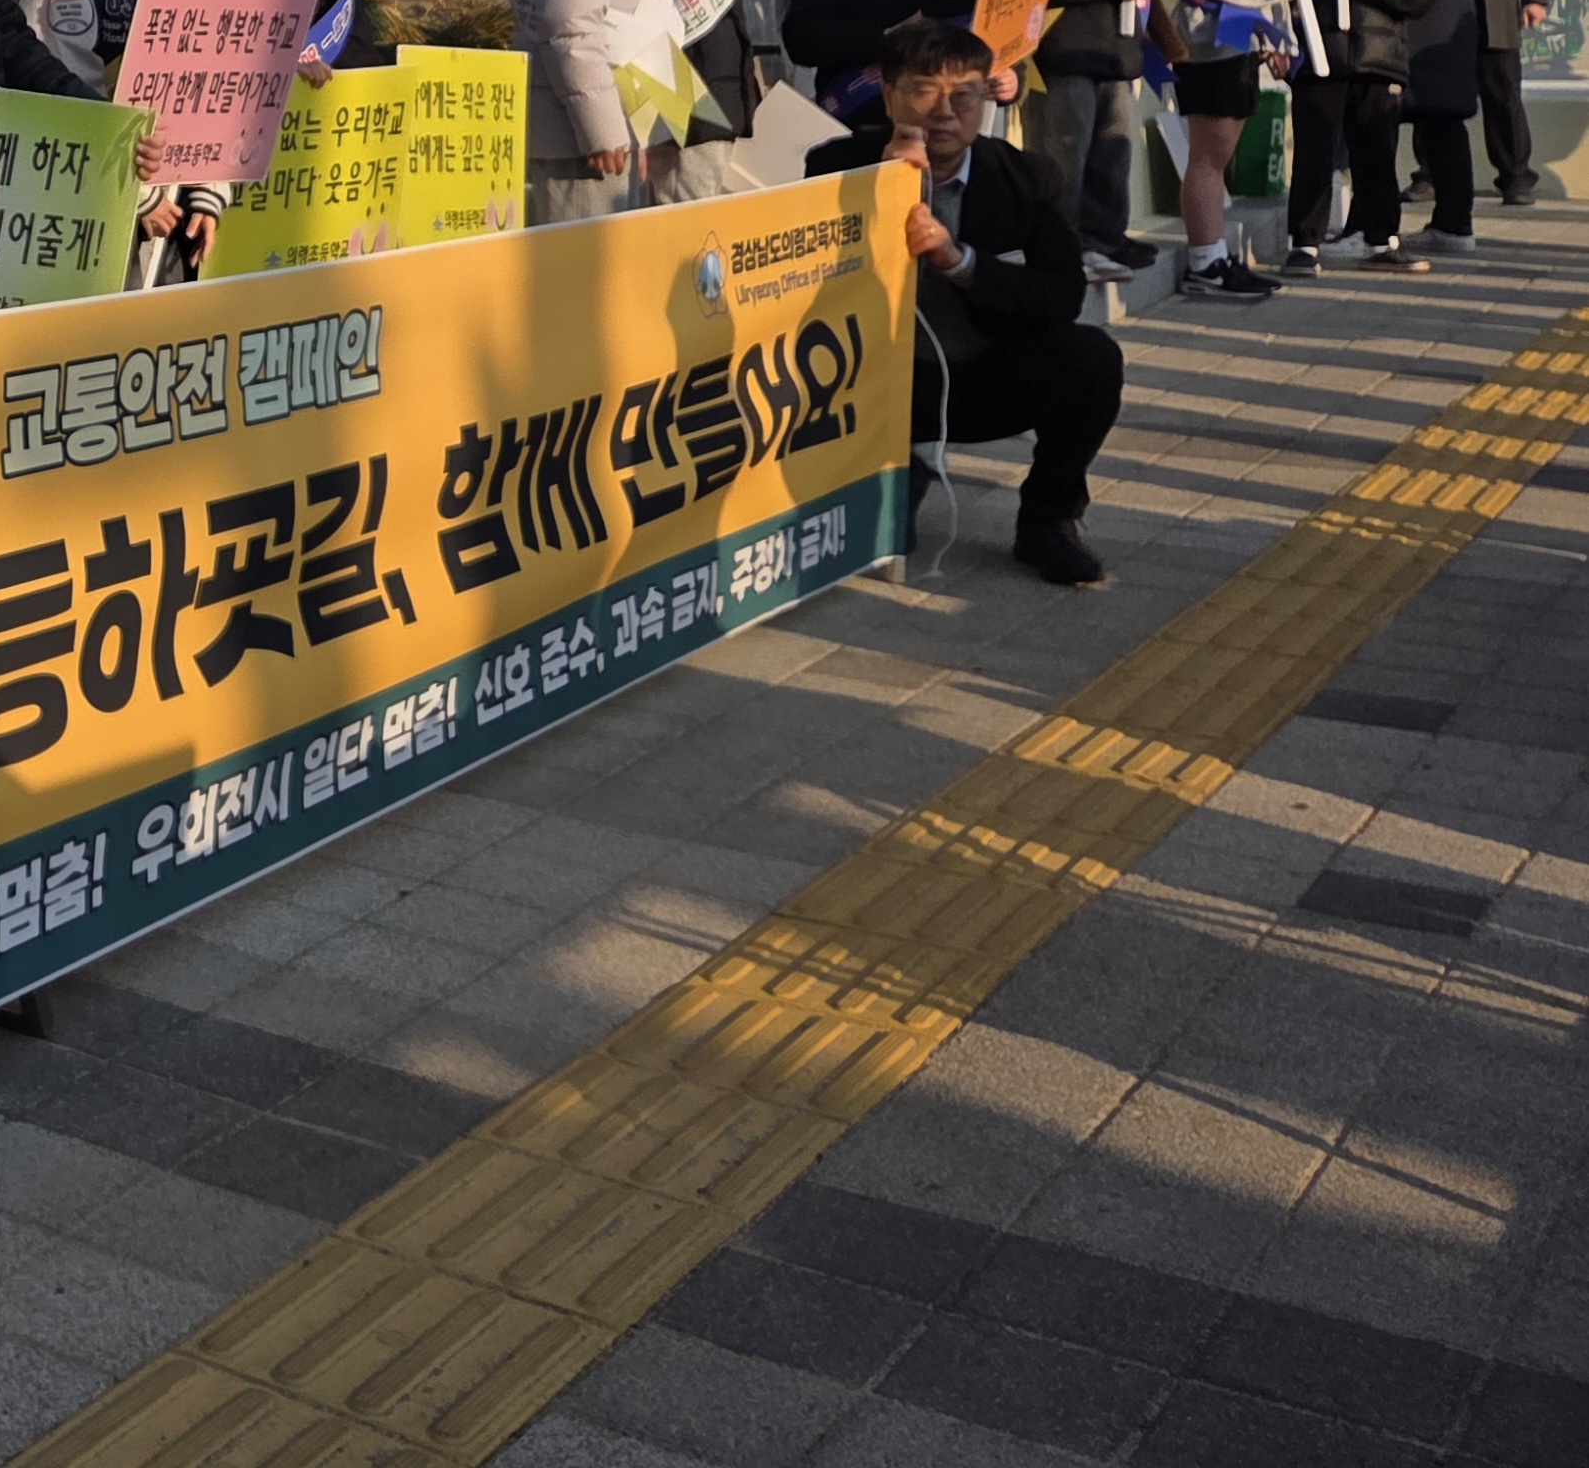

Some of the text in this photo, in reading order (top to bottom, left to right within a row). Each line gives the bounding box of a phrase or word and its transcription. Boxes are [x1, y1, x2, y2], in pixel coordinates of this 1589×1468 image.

[143, 8, 177, 54] 폭력
[177, 8, 210, 54] 없는
[215, 8, 266, 55] 행복한
[266, 12, 301, 55] 학교
[127, 69, 290, 115] 우리가 함께 만들어가요!
[462, 81, 486, 120] 작은
[490, 83, 515, 121] 장난
[280, 101, 406, 153] 없는 우리학교
[31, 135, 91, 194] 하자
[163, 142, 222, 167] 의령초등학교
[462, 133, 485, 172] 깊은
[489, 134, 514, 174] 상처
[323, 156, 399, 206] 웃음가득
[730, 212, 864, 275] 경상남도의령교육지원청
[781, 269, 810, 293] Office
[810, 266, 822, 286] of
[1, 344, 229, 481] 교통안전
[237, 305, 385, 426] 캠페인
[436, 392, 609, 596] 함께
[611, 312, 863, 528] 만들어요!
[129, 749, 294, 885] 우회전시
[301, 718, 376, 810] 일단
[380, 677, 459, 771] 멈춤!
[472, 643, 534, 728] 신호
[538, 618, 607, 698] 준수,
[611, 586, 667, 662] 과속
[669, 557, 726, 633] 금지,
[728, 524, 798, 603] 주정차
[799, 504, 848, 571] 금지!
